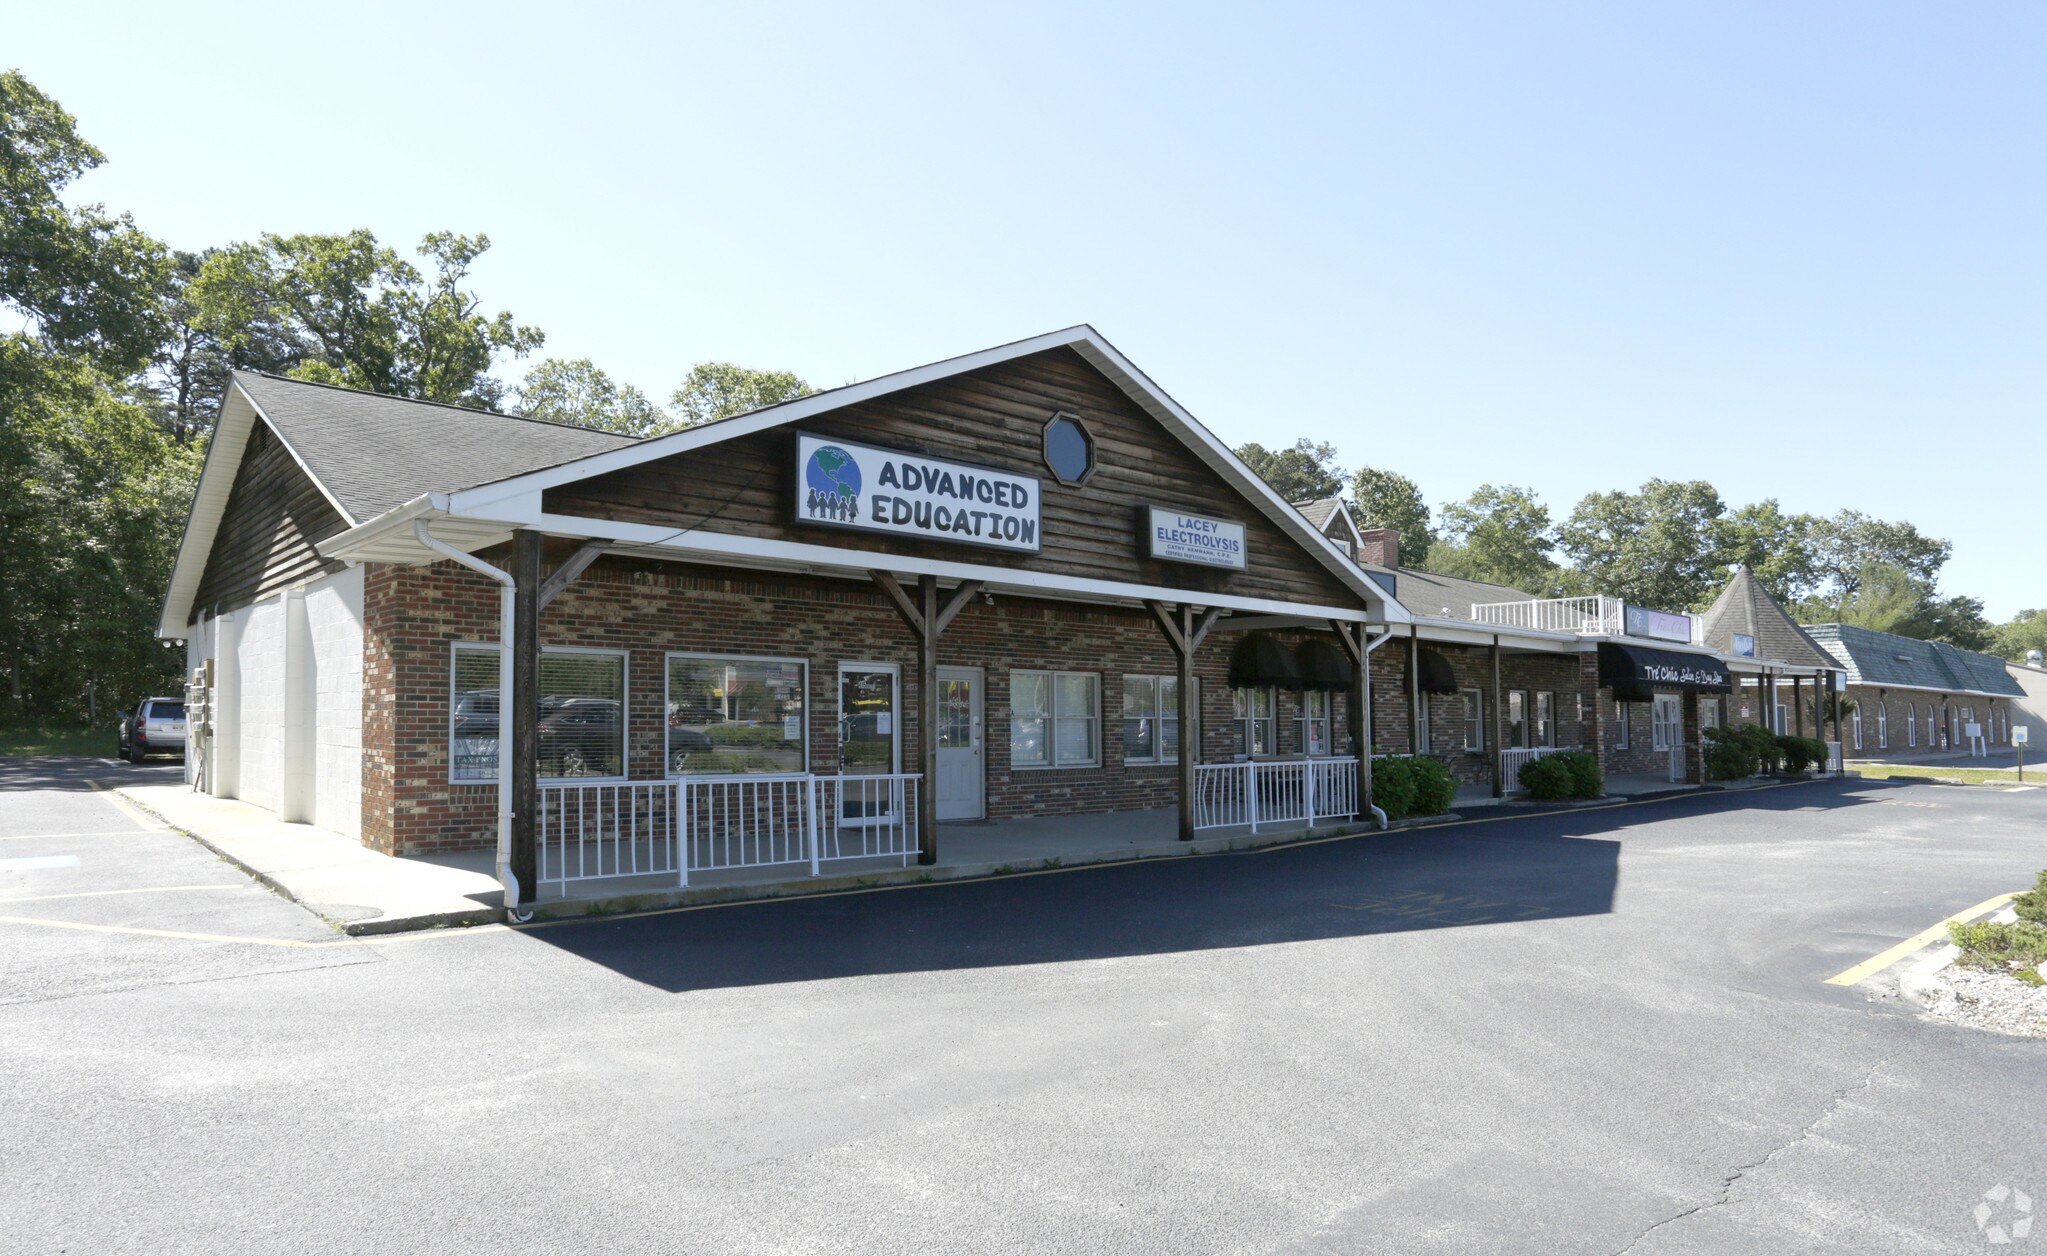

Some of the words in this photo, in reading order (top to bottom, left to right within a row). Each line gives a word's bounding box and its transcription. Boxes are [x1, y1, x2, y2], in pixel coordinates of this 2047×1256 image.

[878, 461, 1028, 509] ADVANCED
[871, 494, 1035, 544] EDUCATION
[1177, 516, 1218, 533] LACEY
[1157, 527, 1239, 552] ELECTROLYSIS
[1661, 666, 1679, 682] Chic
